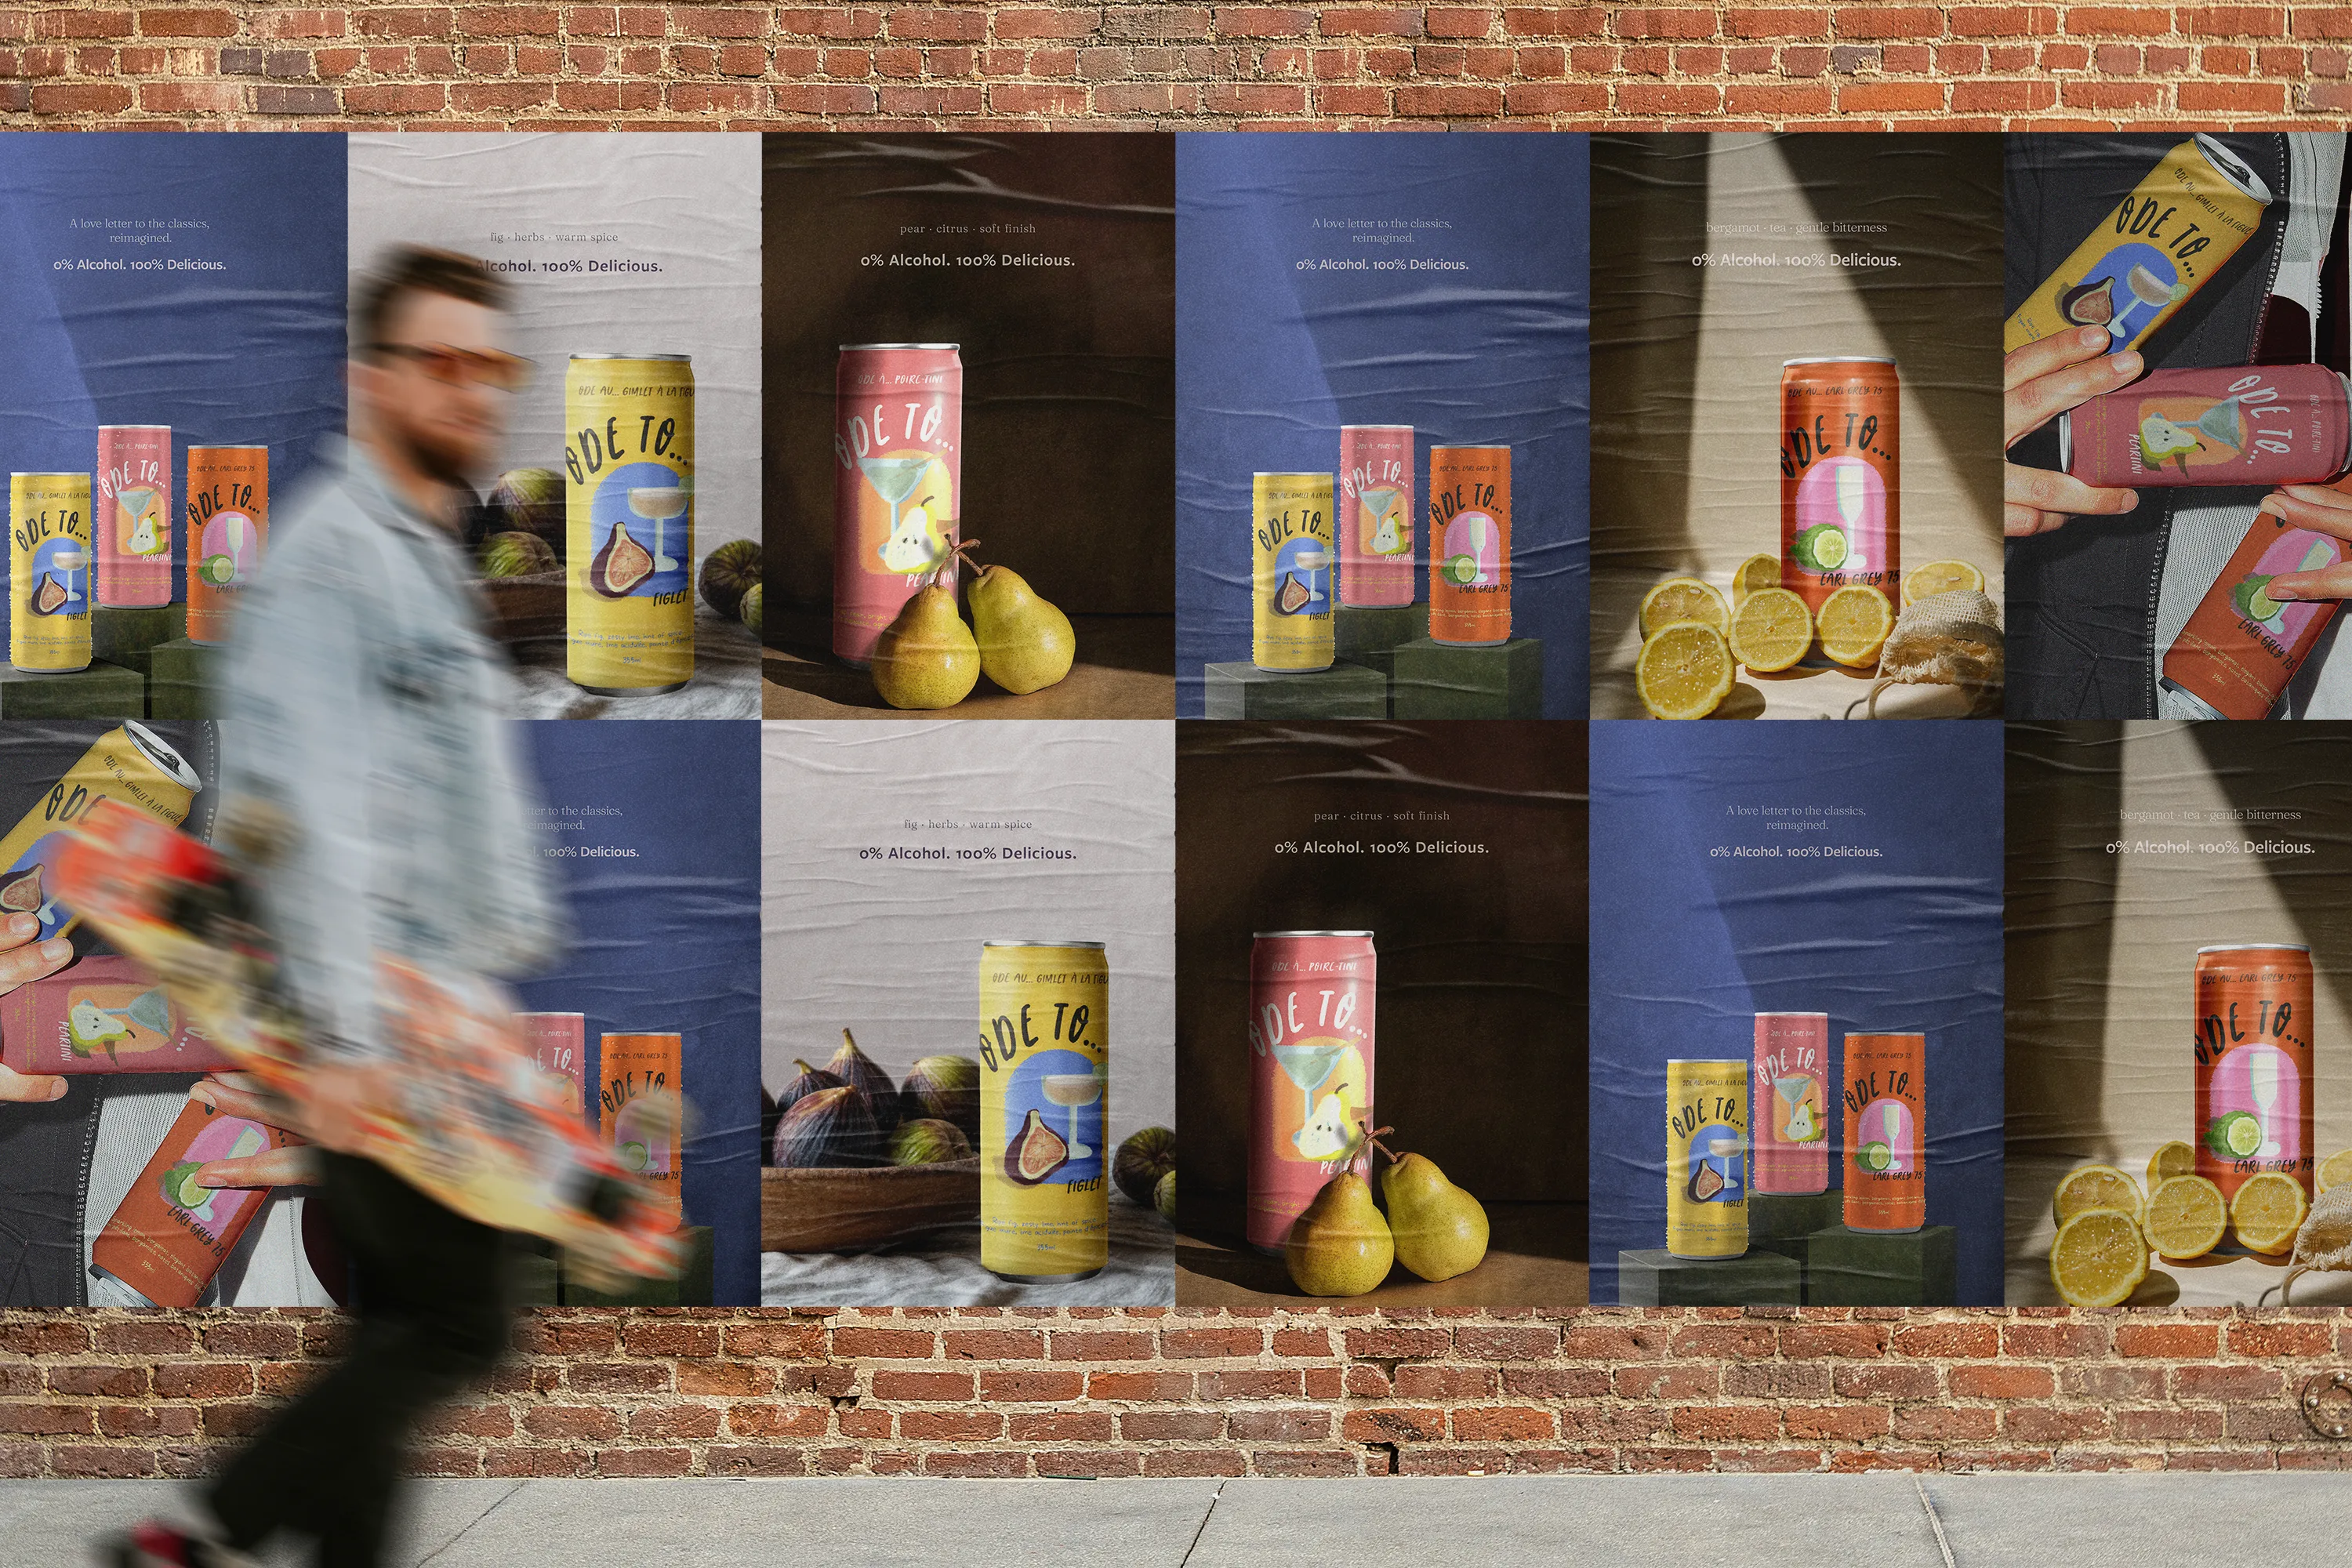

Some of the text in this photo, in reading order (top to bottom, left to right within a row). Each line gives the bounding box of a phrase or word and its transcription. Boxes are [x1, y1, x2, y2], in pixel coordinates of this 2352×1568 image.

[69, 219, 210, 230] A love letter to the classics,
[900, 223, 1036, 235] pear citrus soft finish
[1312, 219, 1453, 230] A love letter to the classics,
[1706, 221, 1888, 235] bergamot tea gentle bitterness
[110, 233, 172, 245] reimagined.
[490, 232, 504, 244] fig
[514, 232, 545, 241] herbs
[590, 232, 619, 244] spice
[1352, 233, 1414, 245] reimagined.
[2115, 196, 2211, 278] ODE TO...
[53, 259, 227, 270] 0% Alcohol. 100% Delicious.
[542, 260, 583, 273] 100%
[588, 259, 663, 273] Delicious.
[861, 253, 1076, 267] 0% Alcohol. 100% Delicious.
[1296, 259, 1469, 270] 0% Alcohol. 100% Delicious.
[1692, 252, 1902, 267] 0% Alcohol. 100% Delicious.
[836, 403, 953, 470] ODE TO...
[566, 416, 688, 486] ODE TO...
[2129, 434, 2143, 474] PEARTINI
[1820, 569, 1900, 586] EARL GREY 75
[652, 588, 688, 607] FIGLET
[2238, 618, 2297, 670] EARL GREY 75
[548, 808, 559, 816] to
[561, 806, 579, 816] the
[581, 806, 623, 818] classics,
[1314, 811, 1450, 822] pear citrus soft finish
[1726, 806, 1867, 818] A love letter to the classics,
[2120, 809, 2302, 822] bergamot tea gentle bitterness
[904, 819, 1033, 831] fig herbs warm spice
[1766, 820, 1828, 833] reimagined.
[543, 846, 577, 858] 100%
[580, 846, 640, 858] Delicious.
[859, 847, 1077, 859] 0% Alcohol. 100% Delicious.
[1275, 840, 1490, 854] 0% Alcohol. 100% Delicious.
[1710, 846, 1883, 858] 0% Alcohol. 100% Delicious.
[2106, 840, 2316, 854] 0% Alcohol. 100% Delicious.
[1250, 990, 1367, 1057] ODE TO...
[980, 1002, 1102, 1073] ODE TO...
[1066, 1176, 1102, 1194] FIGLET
[167, 1205, 227, 1258] EARL GREY 75
